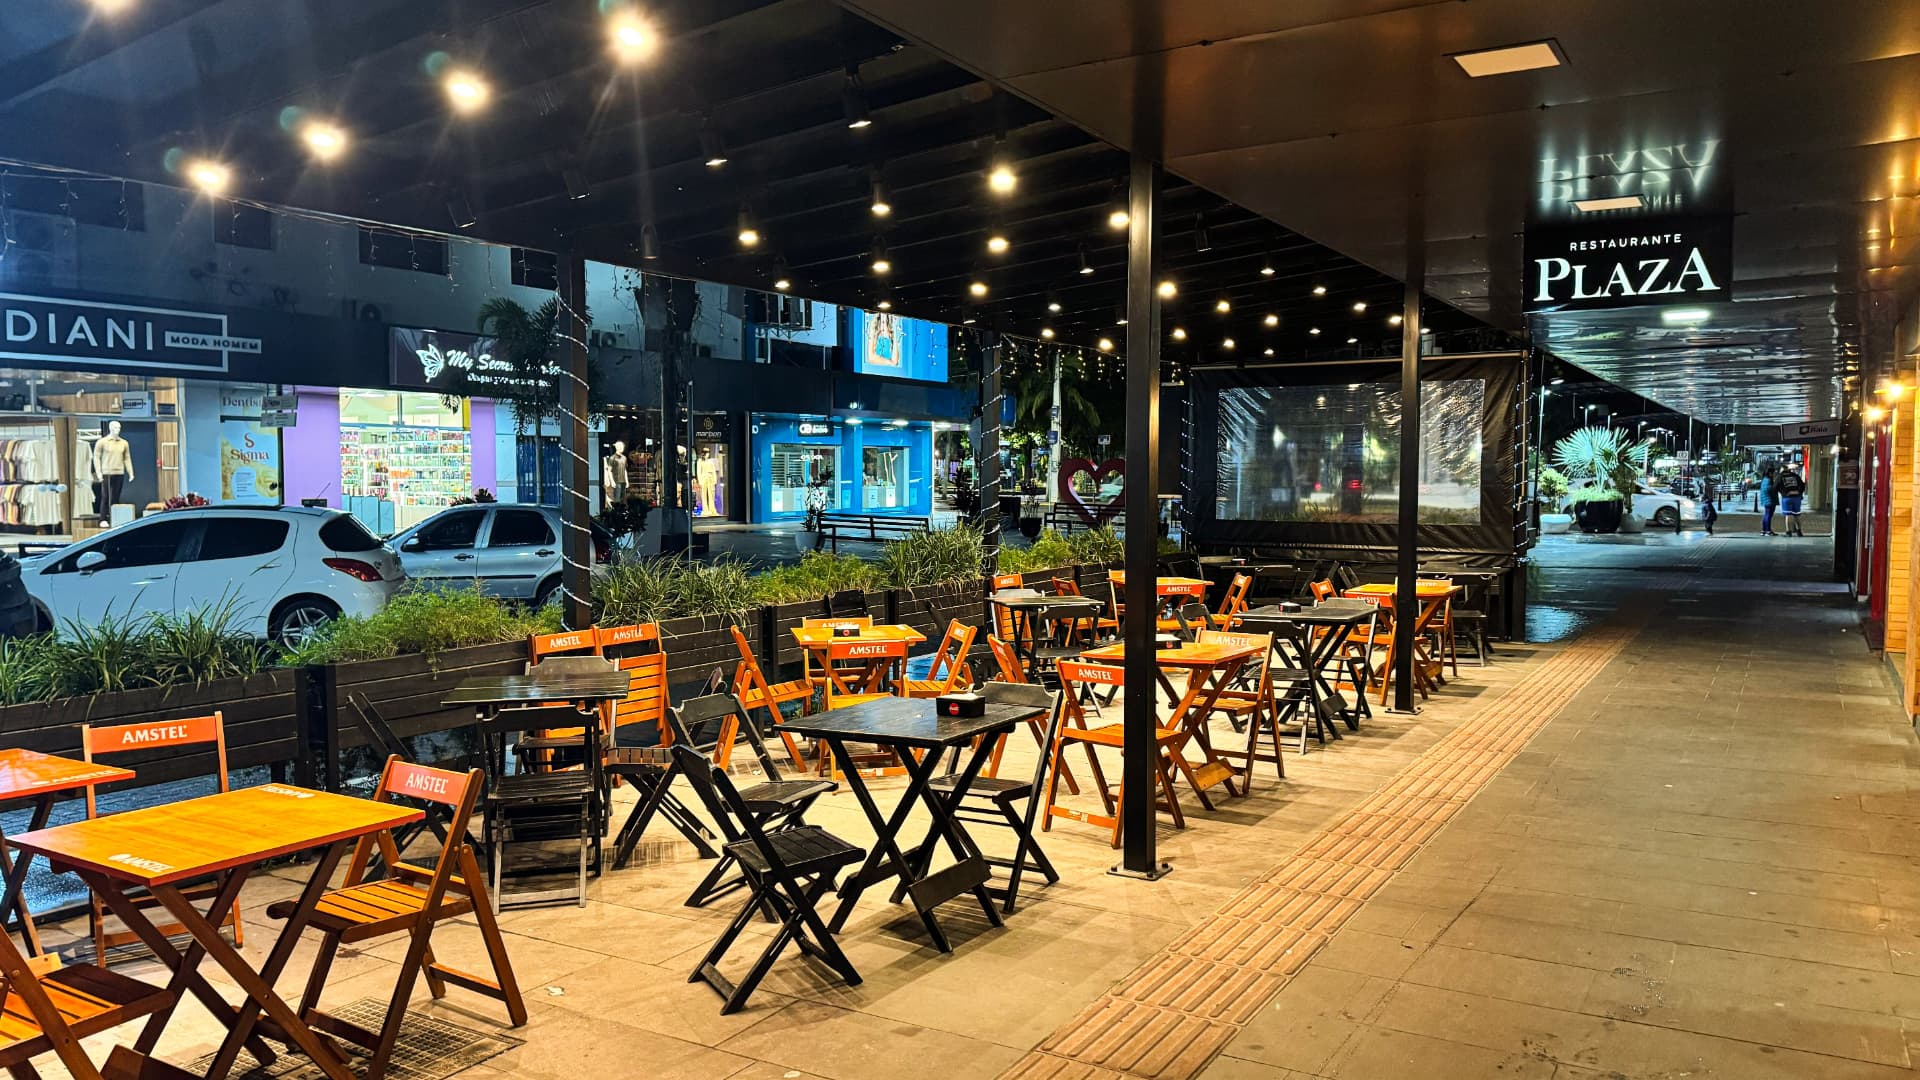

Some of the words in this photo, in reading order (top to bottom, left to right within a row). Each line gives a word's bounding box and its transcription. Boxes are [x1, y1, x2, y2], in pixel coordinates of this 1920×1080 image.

[1569, 233, 1682, 251] RESTAURANTE
[1533, 247, 1721, 301] PLAZA
[5, 308, 154, 351] DIANI
[170, 335, 208, 346] MODA
[213, 339, 258, 350] HOMEM
[446, 349, 473, 371] My
[230, 449, 269, 464] Sigma
[613, 628, 643, 640] AMSTEL
[1216, 635, 1251, 647] AMSTEL
[550, 635, 581, 649] AMSTEL
[849, 645, 888, 655] AMSTEL
[1078, 667, 1113, 681] AMSTEL
[122, 725, 188, 744] AMSTEL
[405, 771, 449, 795] AMSTEL
